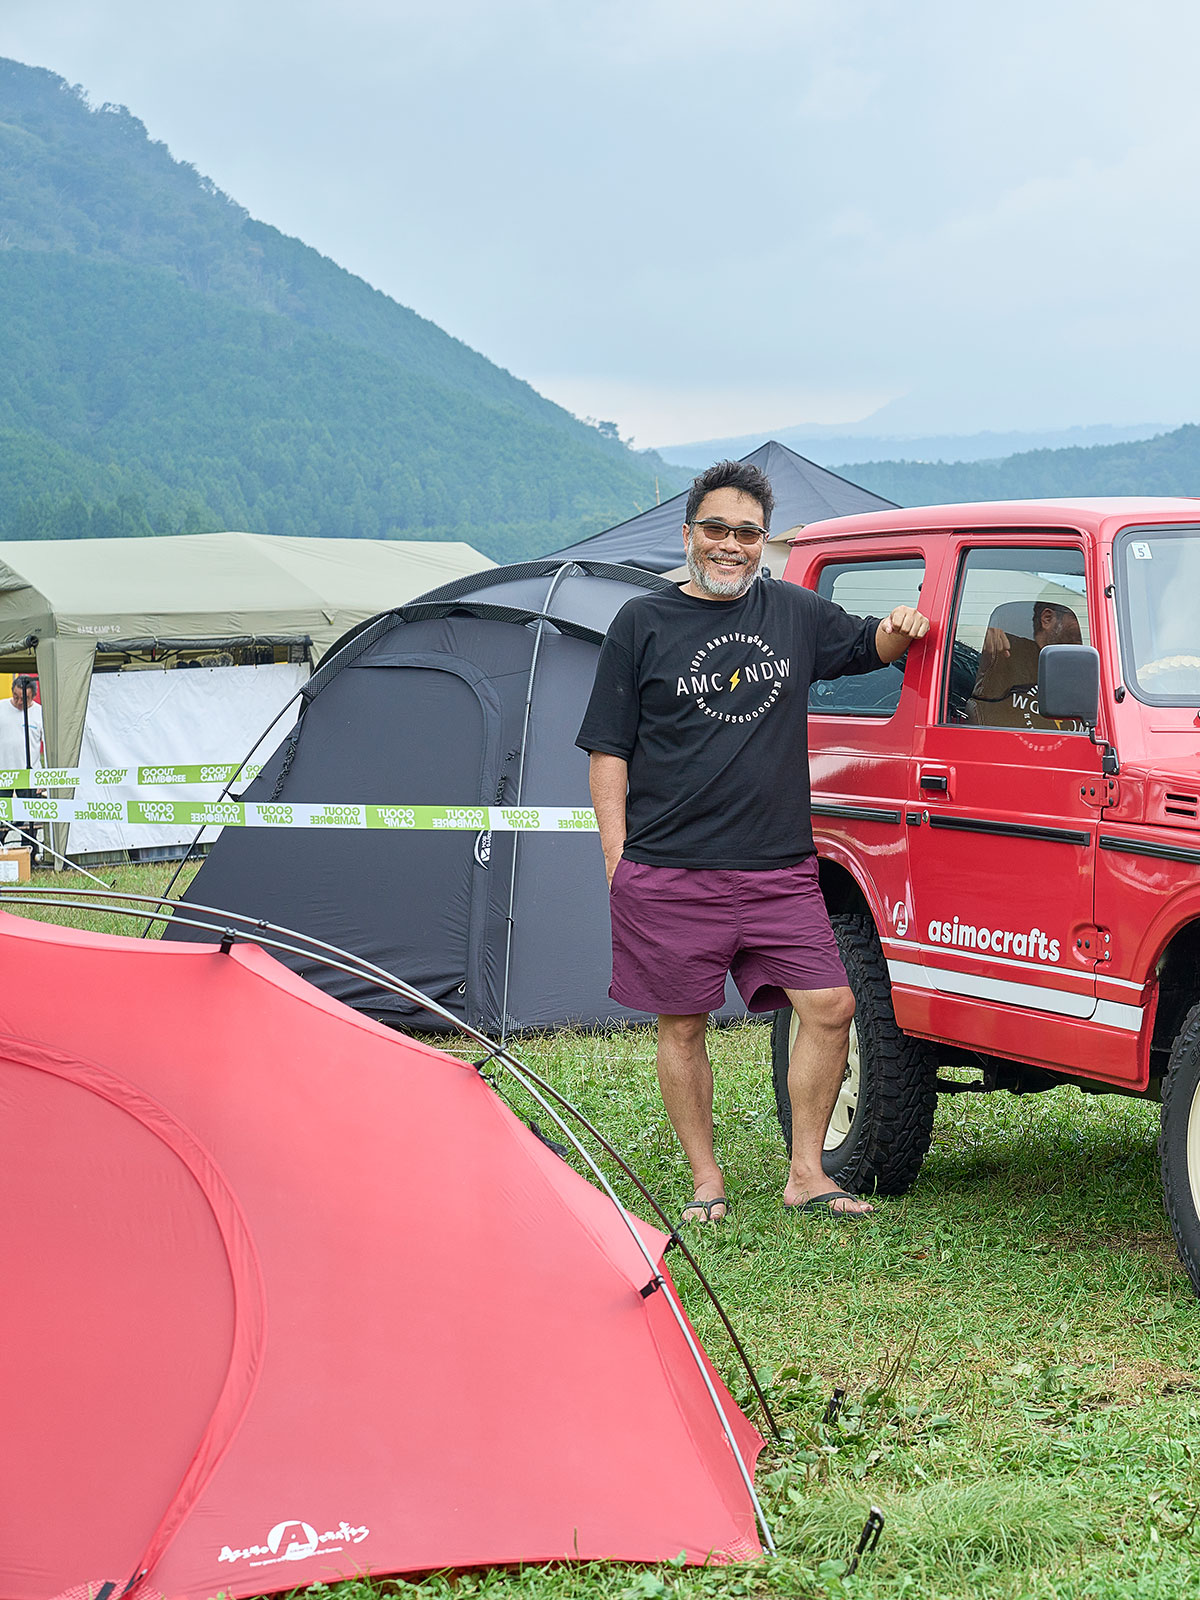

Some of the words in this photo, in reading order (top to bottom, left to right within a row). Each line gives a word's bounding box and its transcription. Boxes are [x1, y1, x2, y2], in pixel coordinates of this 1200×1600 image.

[744, 658, 790, 683] NDW
[676, 672, 723, 696] AMC
[95, 769, 128, 777] GOOUT
[142, 767, 174, 776] GOOUT
[200, 766, 232, 774] GOOUT
[0, 771, 19, 780] OUT
[142, 775, 186, 784] JAMBOREE
[200, 773, 227, 781] CAMP
[34, 778, 80, 786] JAMBOREE
[95, 777, 122, 785] CAMP
[928, 915, 1060, 962] asimocrafts
